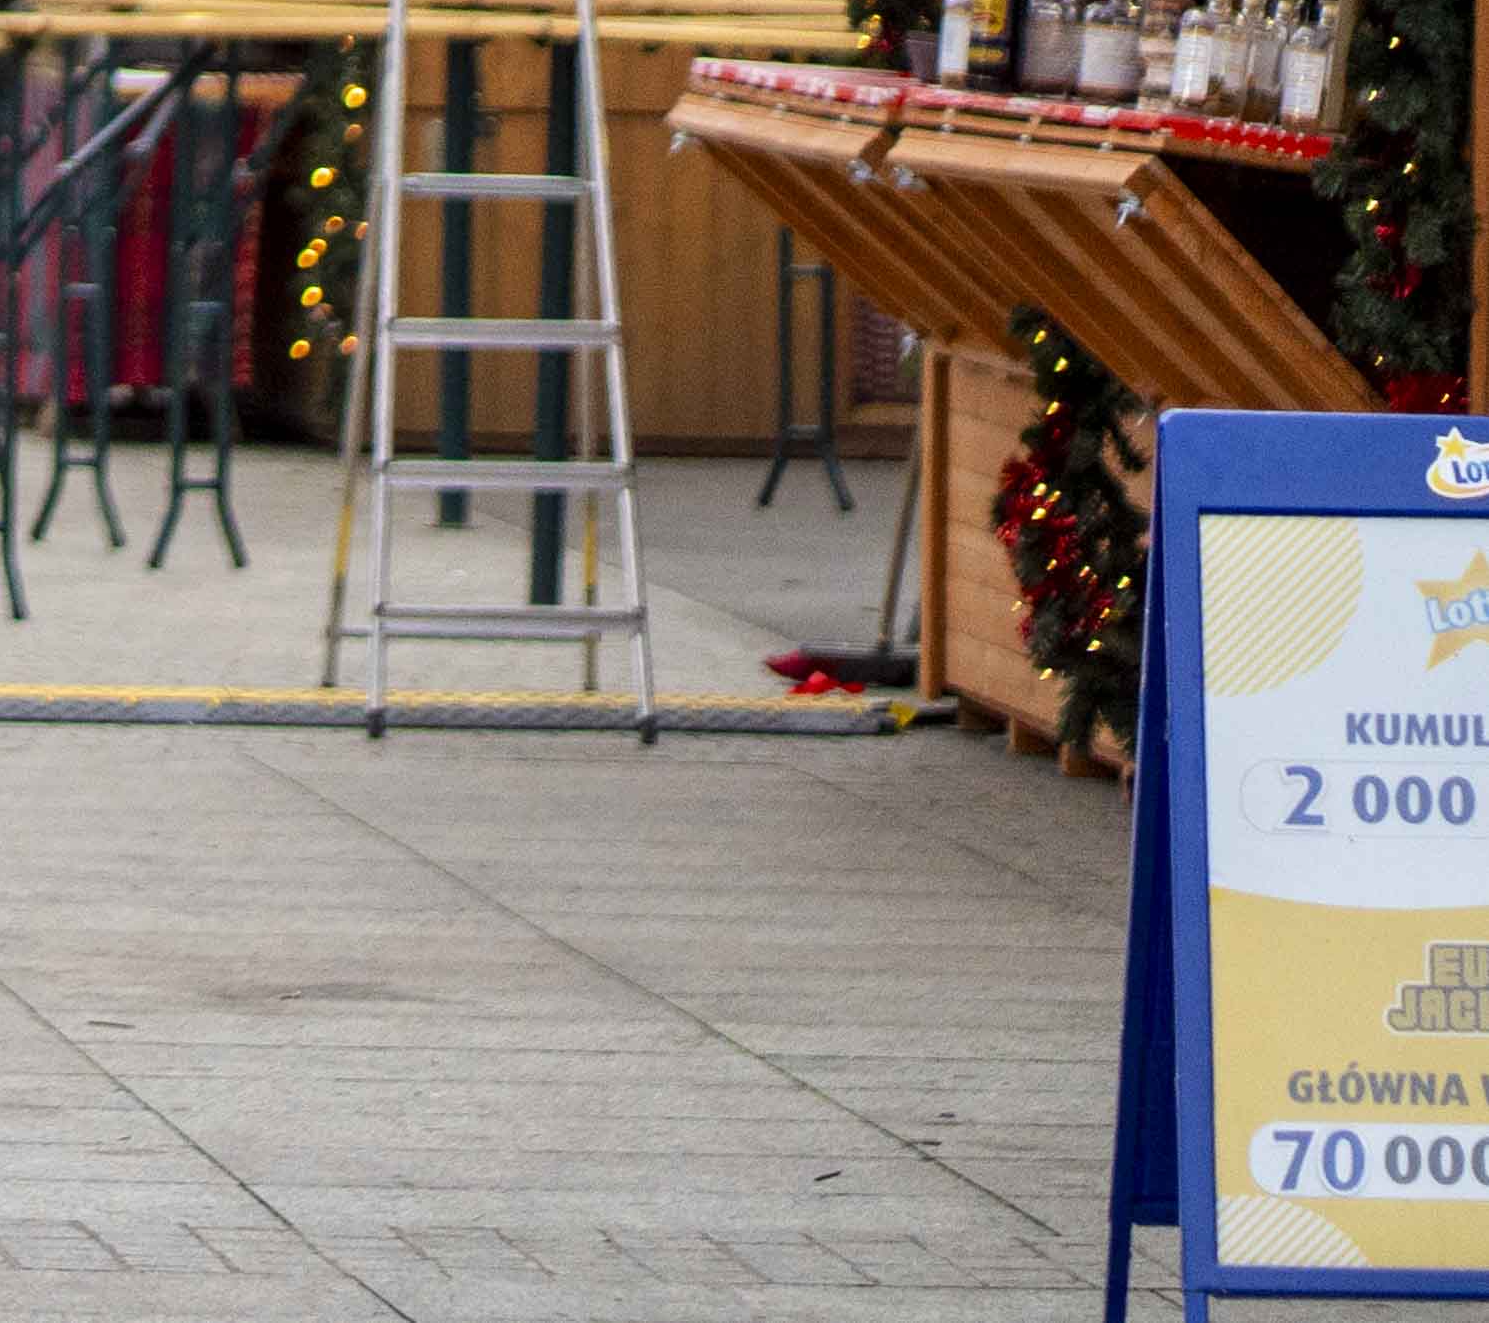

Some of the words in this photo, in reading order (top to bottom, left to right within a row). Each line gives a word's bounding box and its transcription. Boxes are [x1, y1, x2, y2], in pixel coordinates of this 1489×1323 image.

[1283, 765, 1325, 827] 2
[1352, 774, 1476, 826] 000
[1287, 1061, 1470, 1107] GŁÓWNA
[1272, 1128, 1366, 1192] 70
